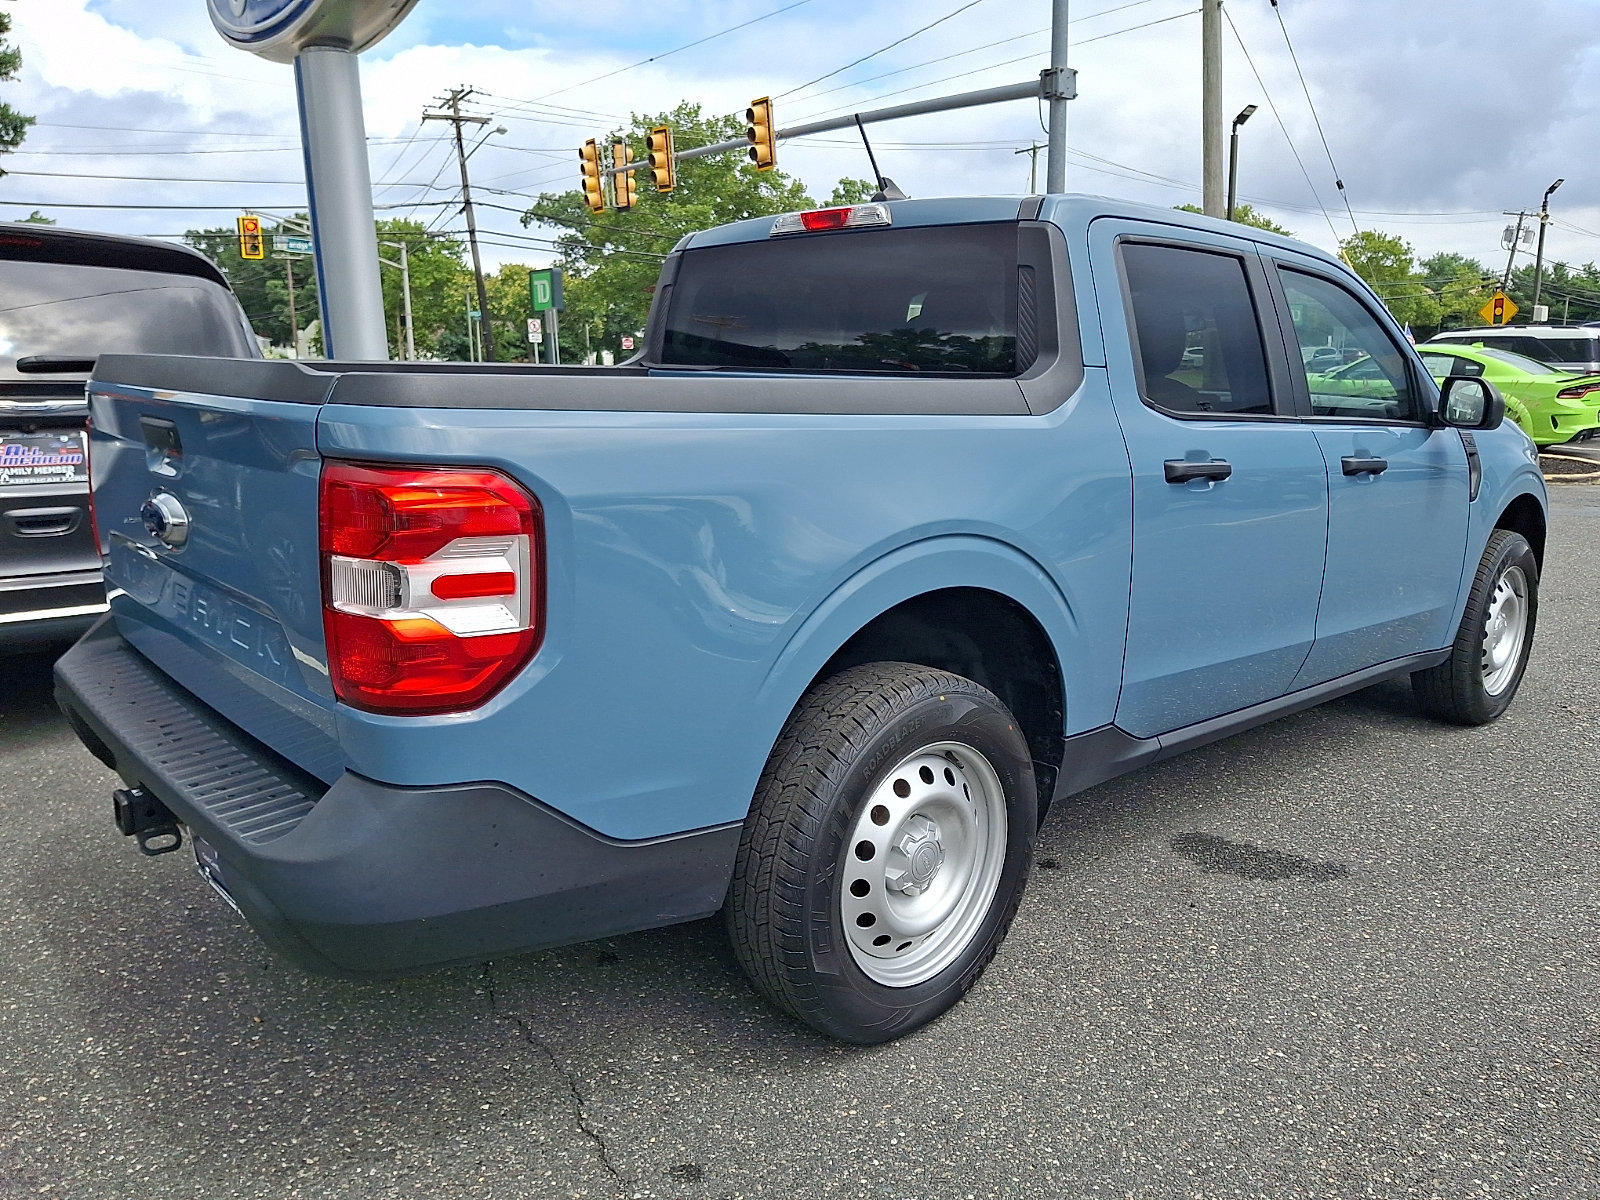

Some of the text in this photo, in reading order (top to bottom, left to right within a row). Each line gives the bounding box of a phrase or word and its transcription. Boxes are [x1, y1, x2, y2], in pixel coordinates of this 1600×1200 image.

[533, 279, 550, 304] TD
[0, 453, 83, 466] MERICAN
[34, 465, 75, 475] MEMBER
[863, 716, 927, 780] ROADBLAZER
